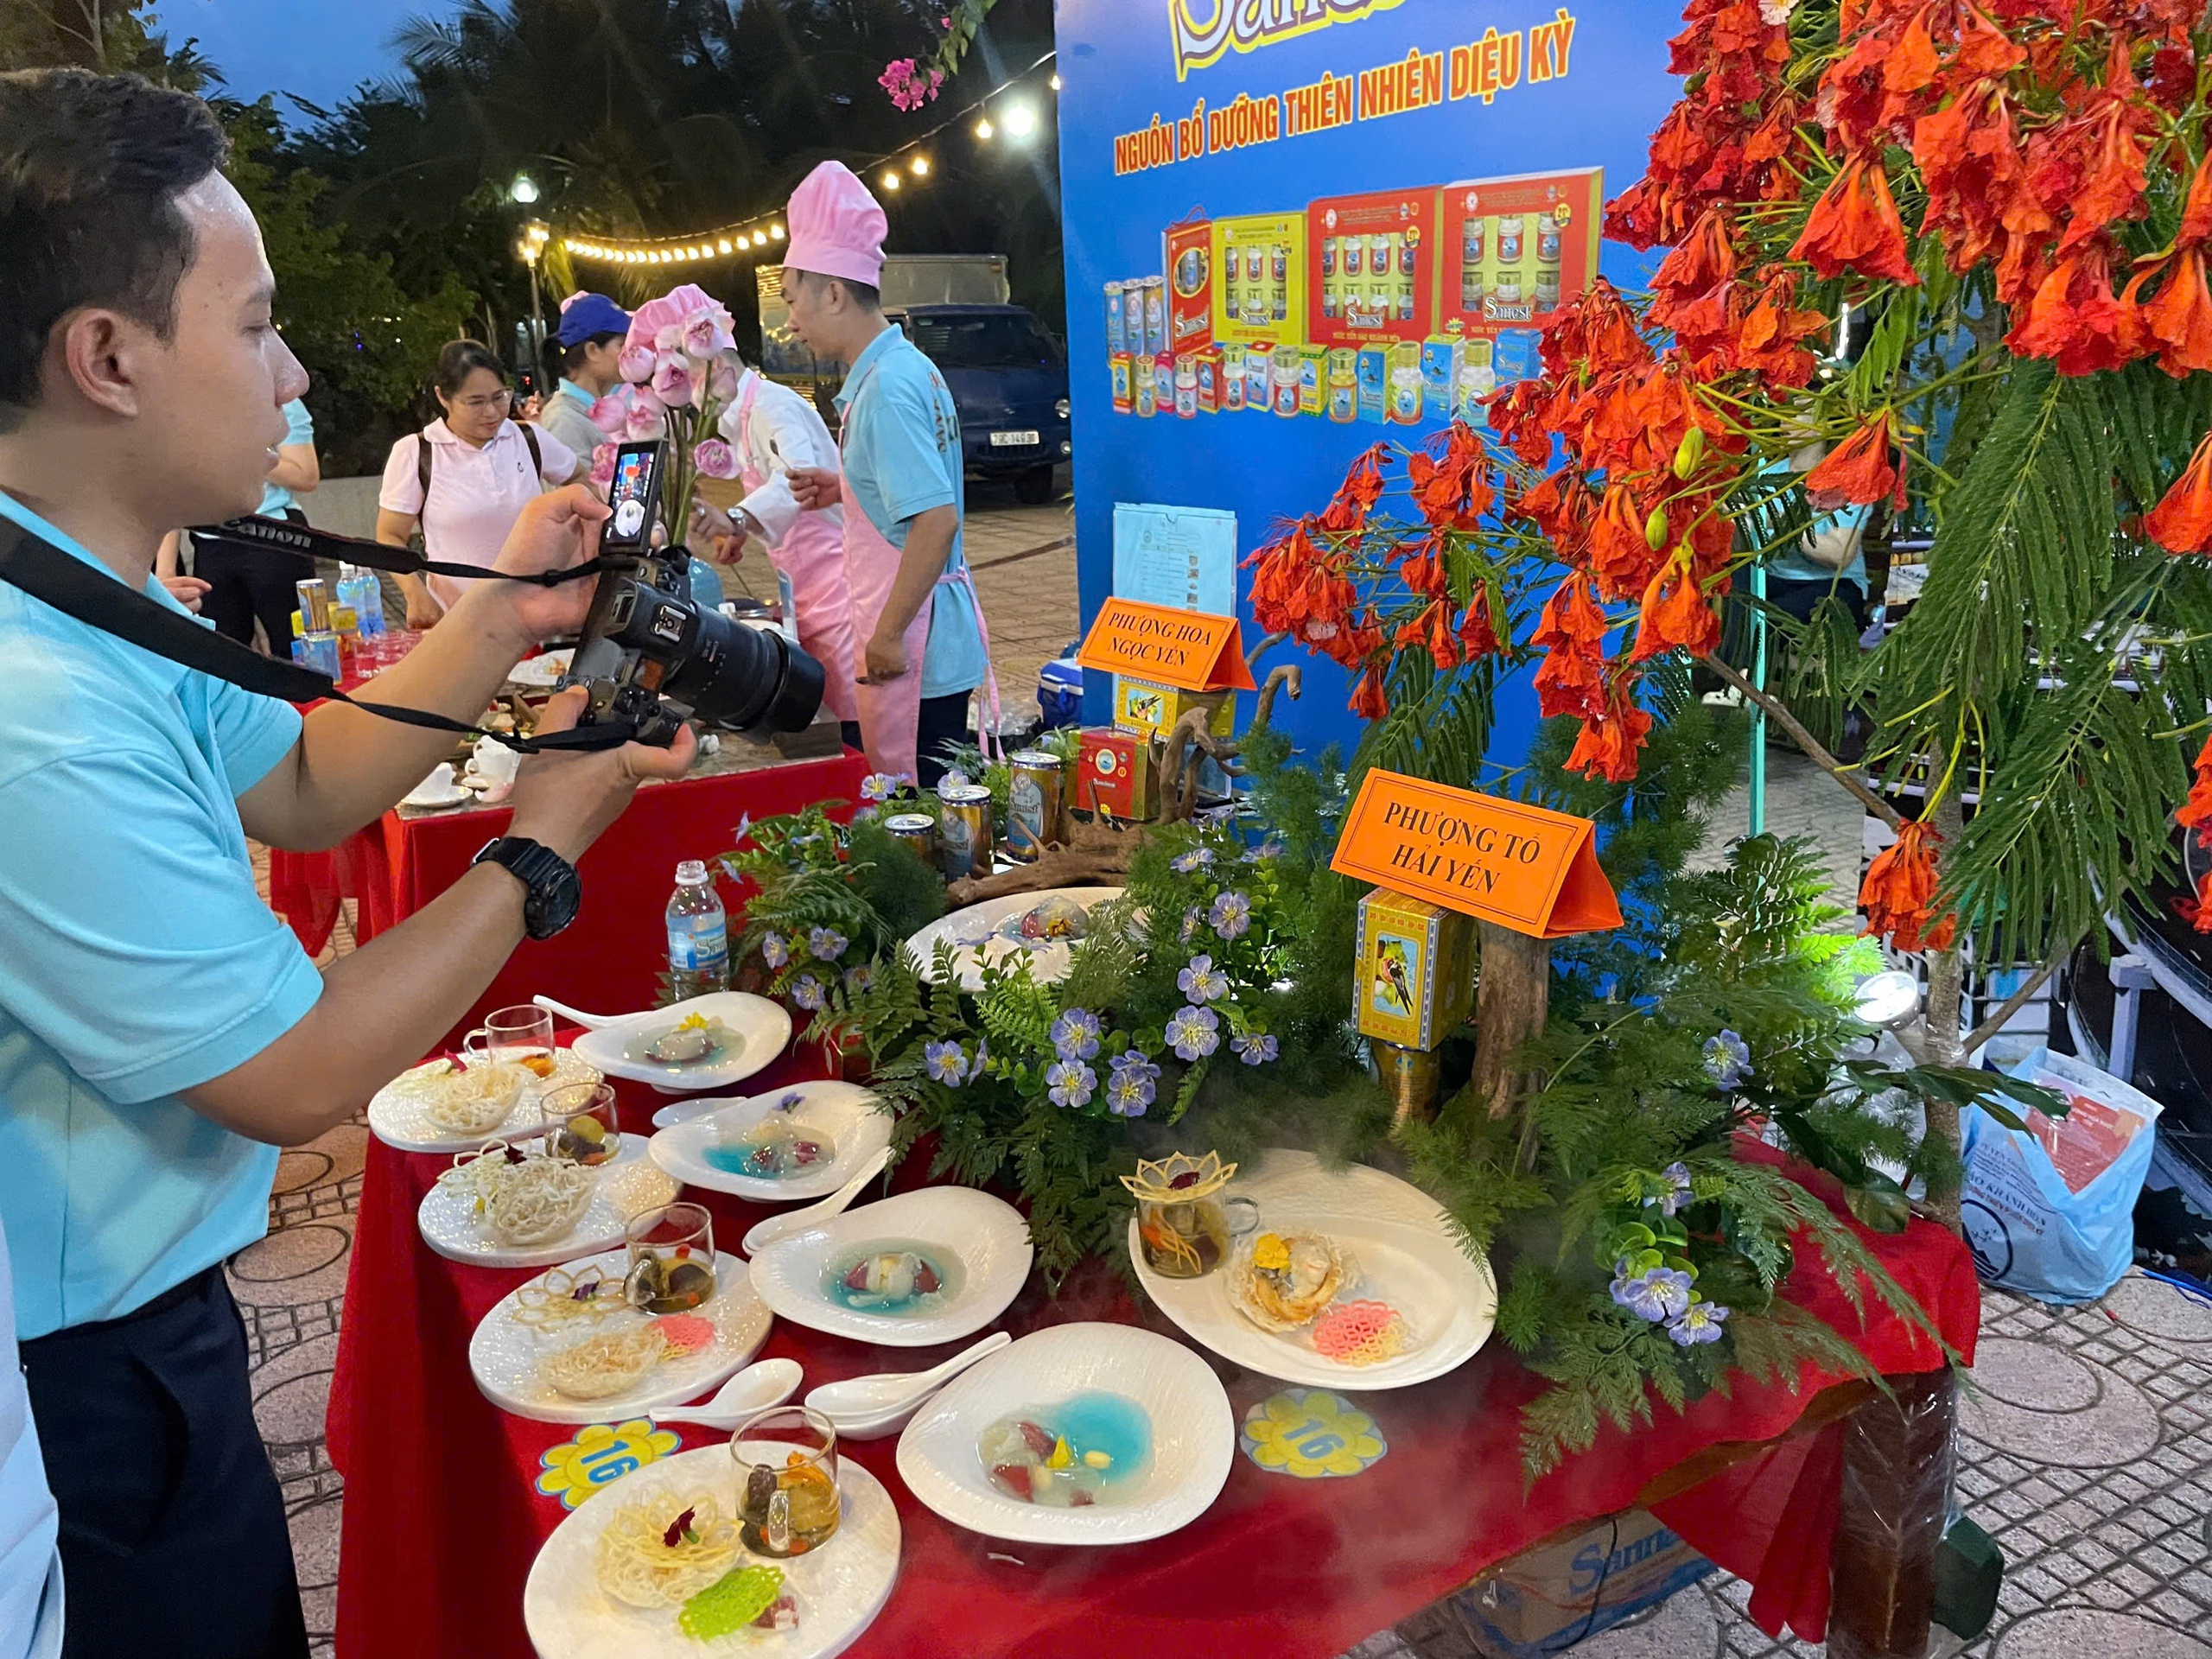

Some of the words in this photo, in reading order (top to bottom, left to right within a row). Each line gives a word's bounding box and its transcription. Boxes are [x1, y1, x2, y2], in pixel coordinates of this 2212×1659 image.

[1115, 113, 1174, 175] NGUỒN
[1179, 98, 1205, 161] BỔ
[1209, 92, 1279, 154] DƯỠNG
[1283, 71, 1353, 137] THIÊN
[1358, 48, 1443, 120] NHIÊN
[1449, 27, 1522, 105] DIỆU
[1529, 7, 1576, 83] KỲ
[1109, 613, 1175, 638] PHƯỢNG
[1176, 625, 1211, 645] HOA
[1108, 637, 1154, 660] NGỌC
[1155, 644, 1190, 668] YẾN
[1383, 802, 1497, 852] PHƯỢNG
[1390, 842, 1442, 877] HẢI
[1443, 859, 1502, 894] YẾN
[1283, 1419, 1345, 1459] 16
[580, 1440, 639, 1484] 16
